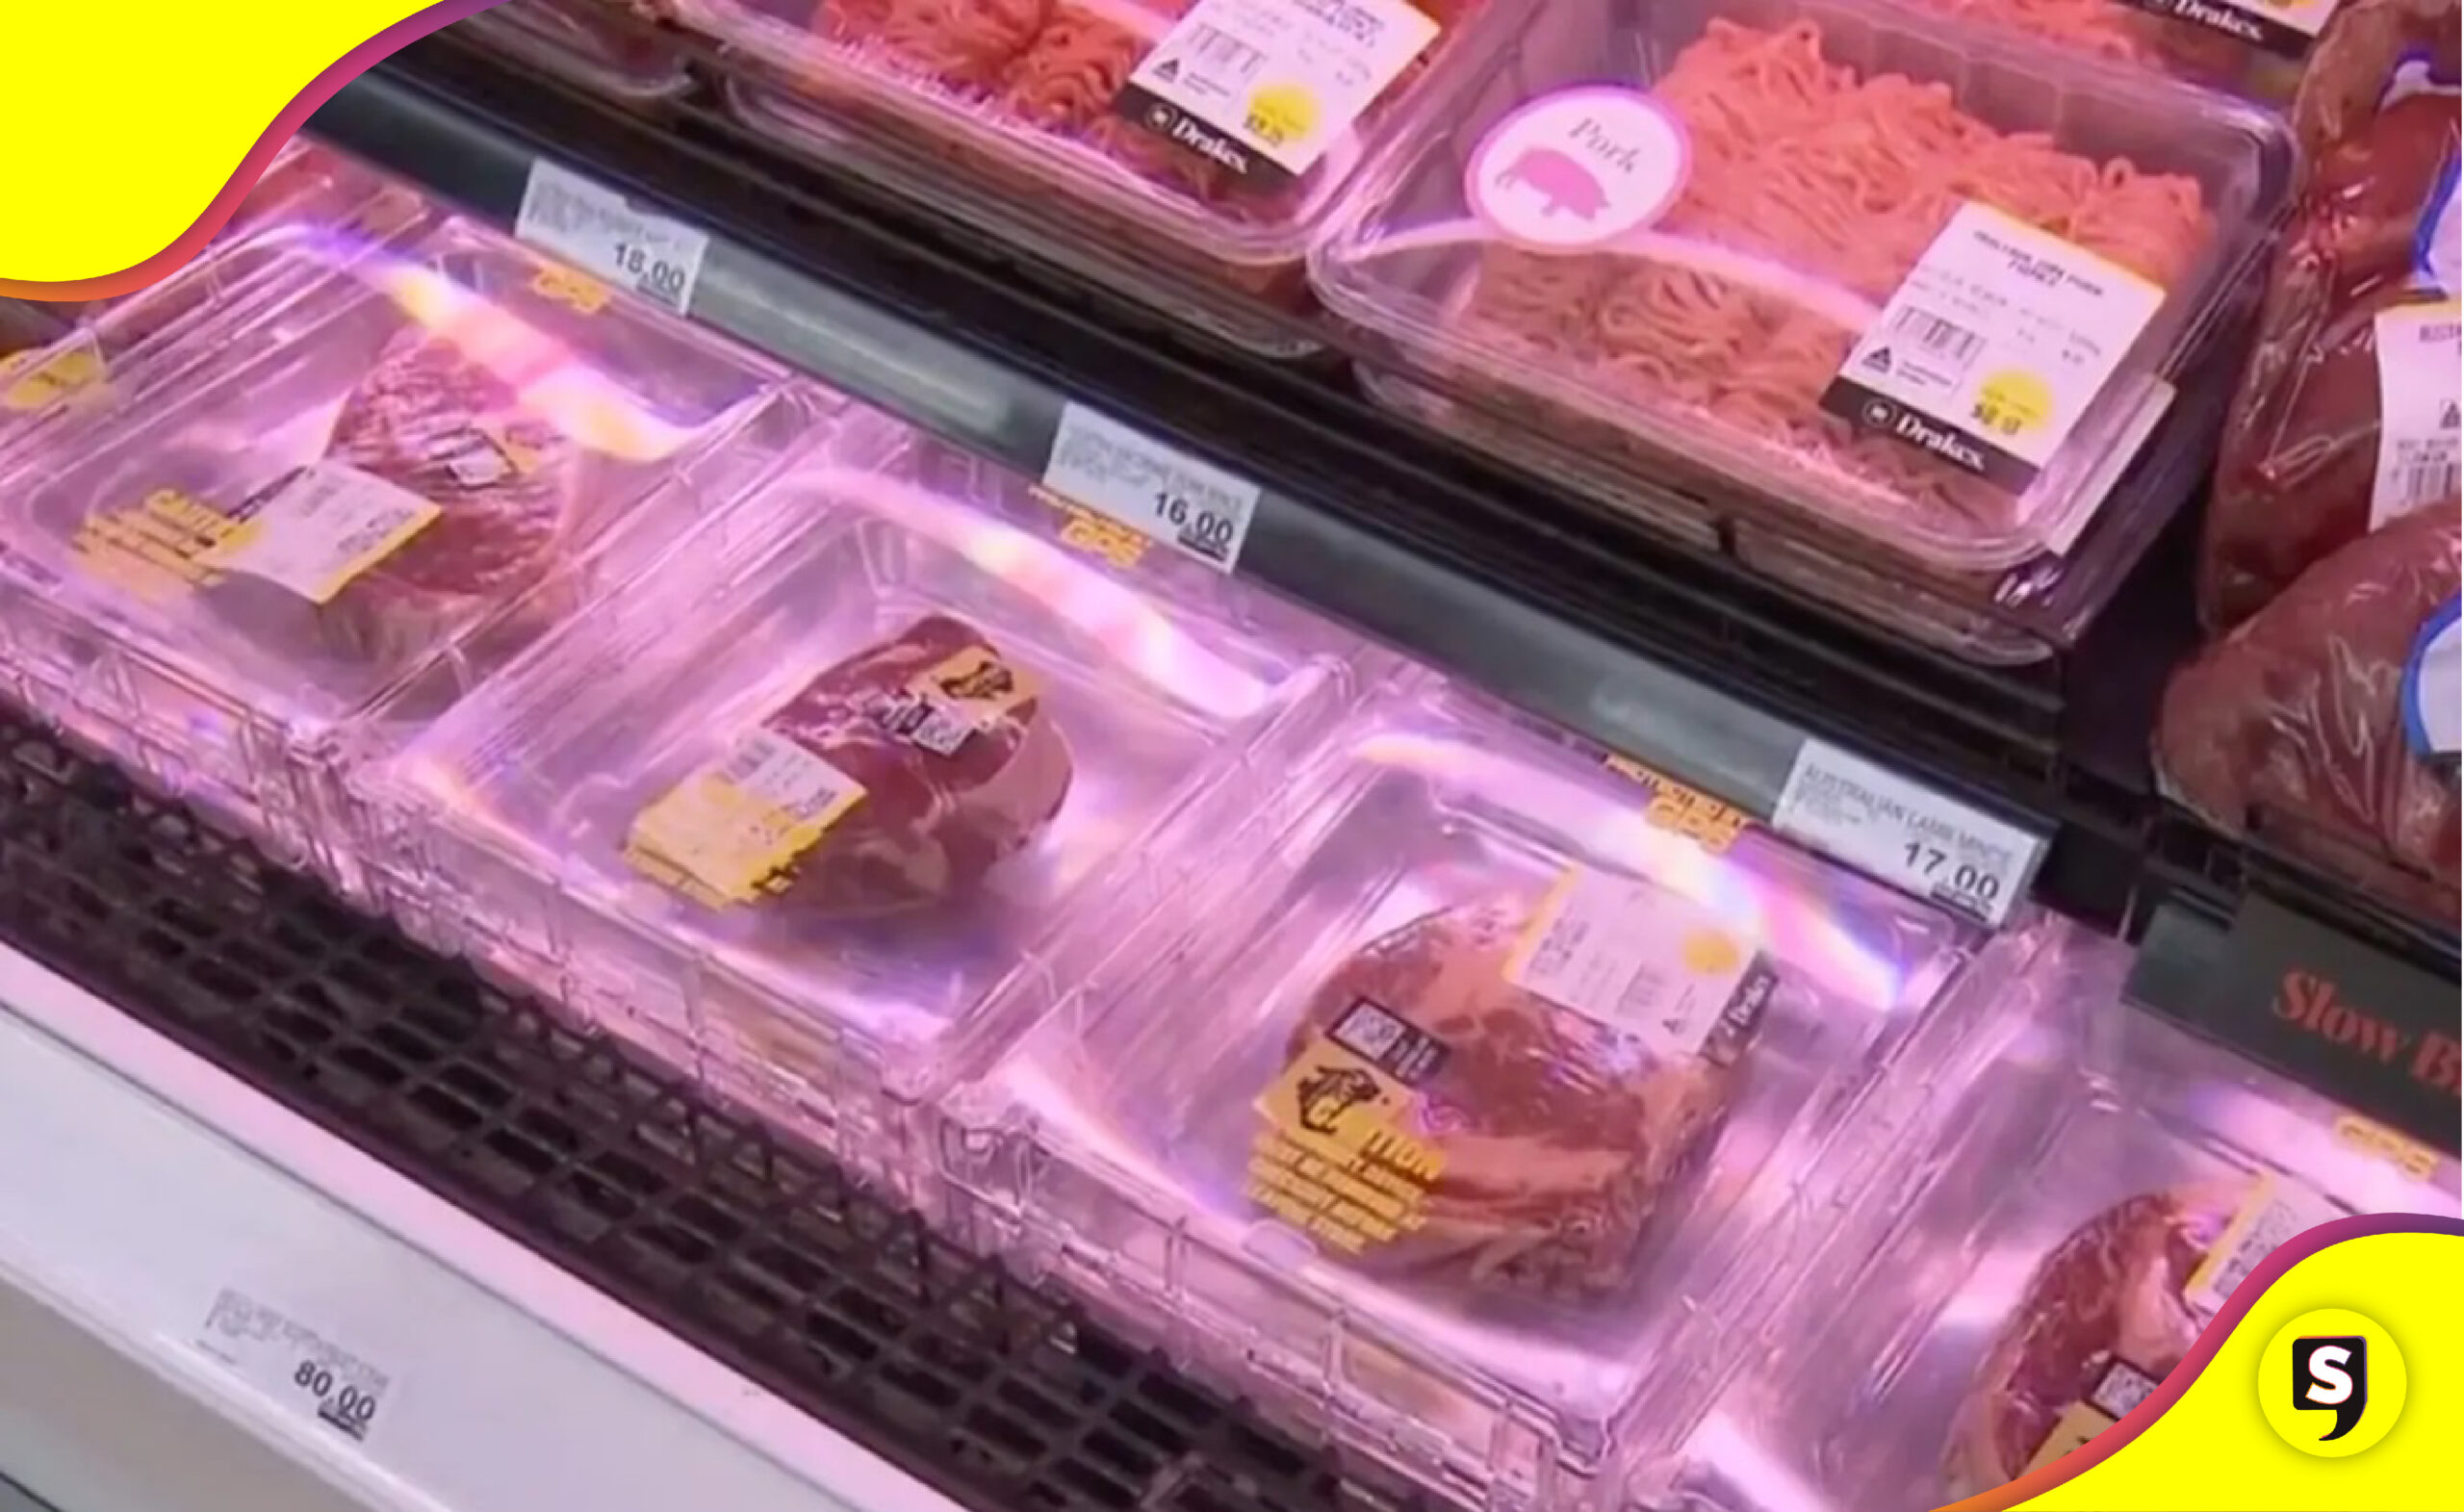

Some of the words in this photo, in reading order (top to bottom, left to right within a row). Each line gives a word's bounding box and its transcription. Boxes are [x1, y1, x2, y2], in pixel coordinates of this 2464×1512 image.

[1568, 116, 1641, 174] Pork
[614, 243, 686, 292] 18.00
[1894, 413, 1986, 472] Drakes
[1155, 492, 1234, 545] 16.00
[1904, 840, 2000, 901] 17.00
[2272, 967, 2406, 1063] Slow
[294, 1359, 376, 1422] 80.00
